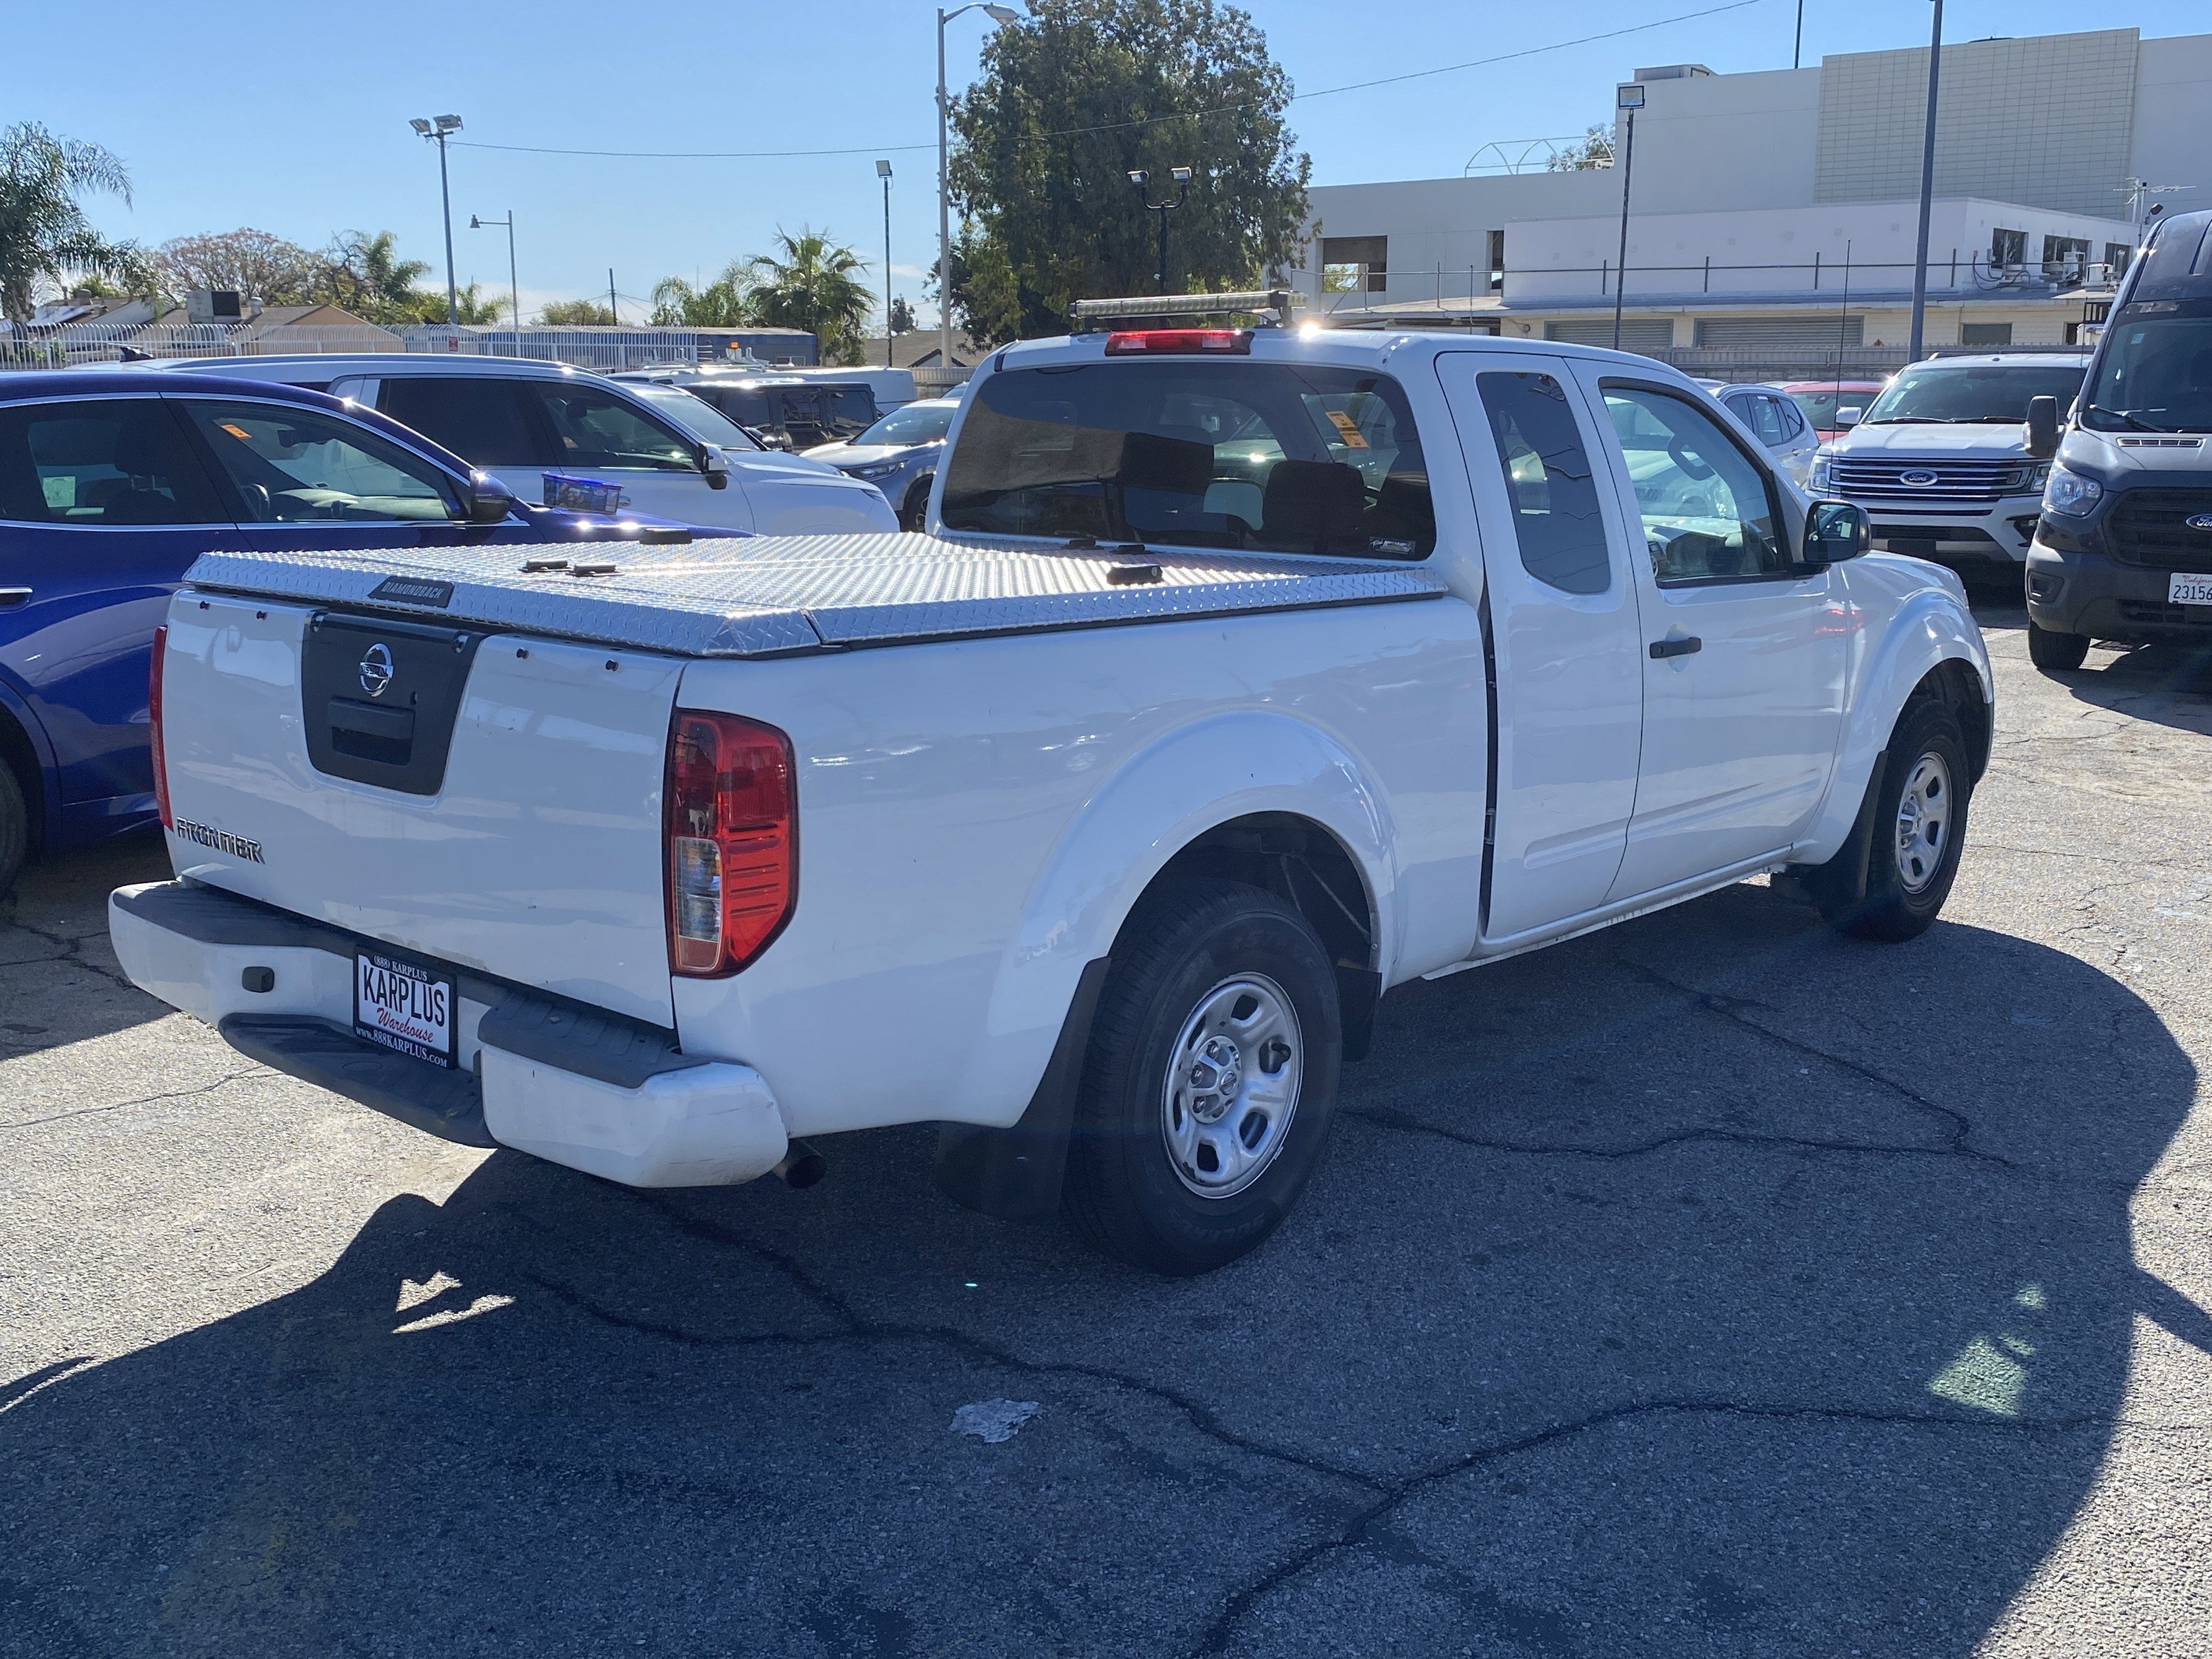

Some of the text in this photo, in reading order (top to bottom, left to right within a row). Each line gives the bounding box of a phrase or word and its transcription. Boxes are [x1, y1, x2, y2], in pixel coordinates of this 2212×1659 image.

[381, 582, 445, 599] DIAMONDBACK
[2173, 585, 2212, 600] 23156
[177, 816, 266, 865] FRONTIER
[374, 955, 427, 981] (888) KARPLUS
[363, 964, 445, 1028] KARPLUS
[376, 1007, 434, 1043] Warehouse
